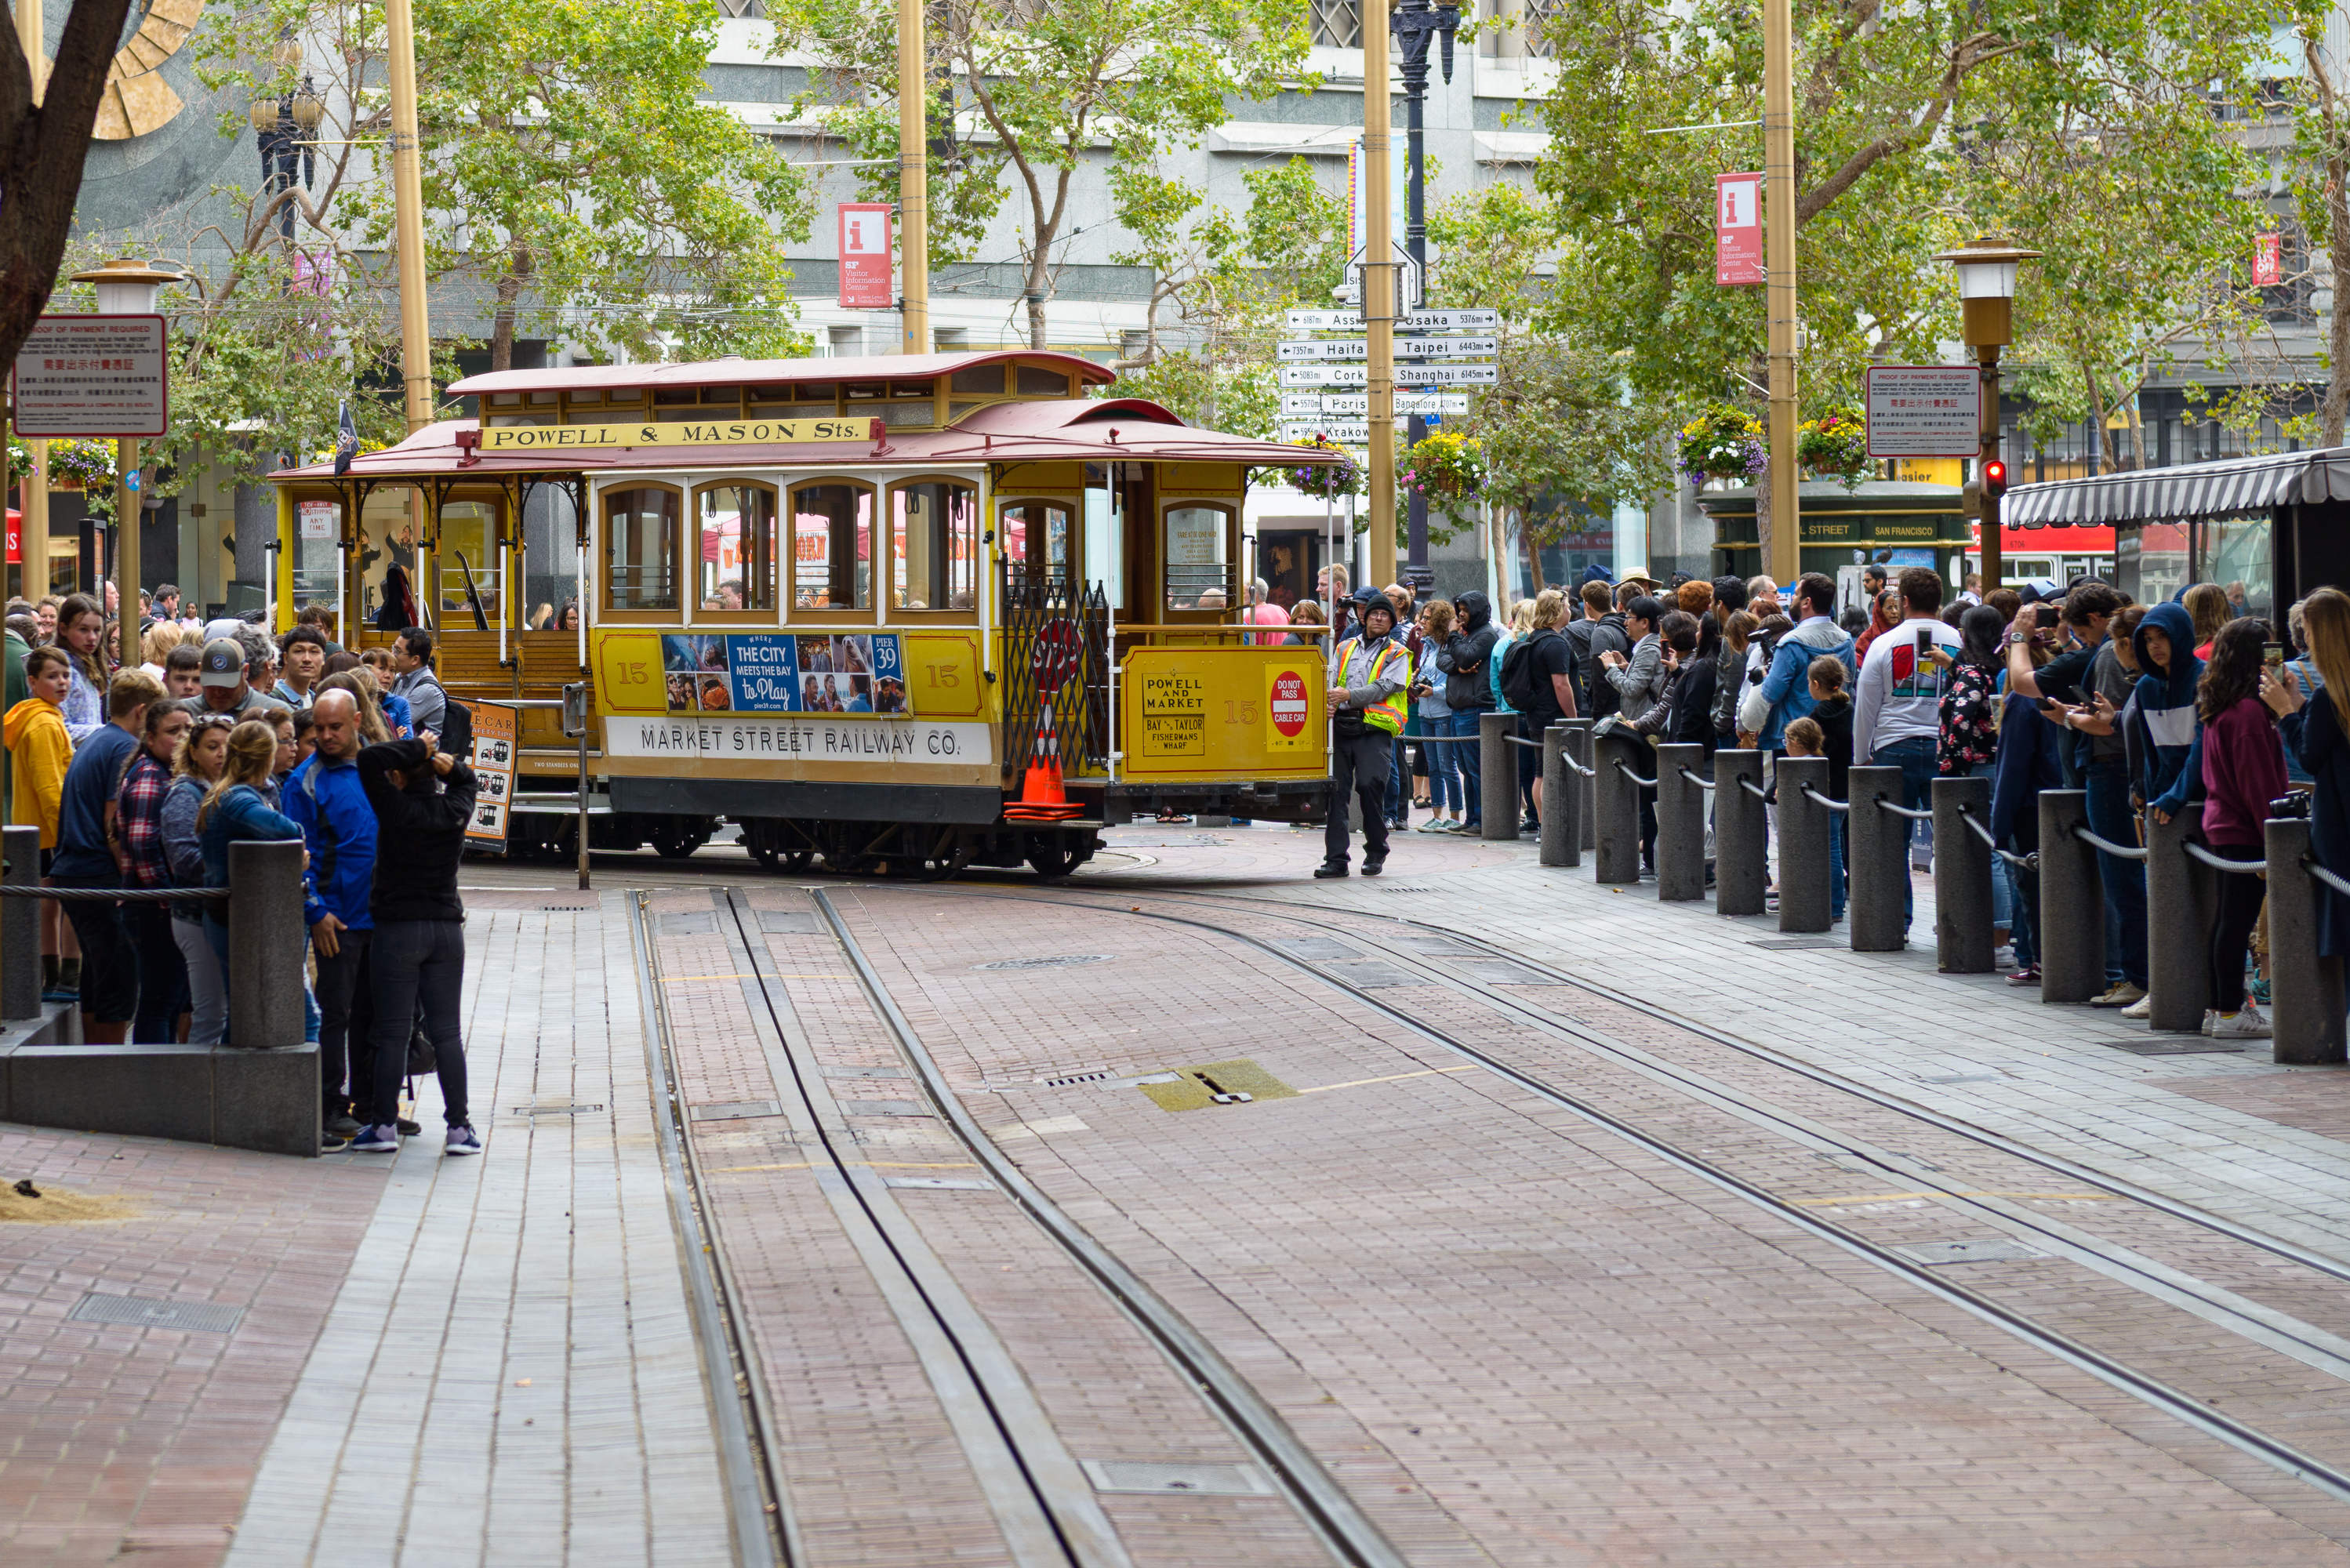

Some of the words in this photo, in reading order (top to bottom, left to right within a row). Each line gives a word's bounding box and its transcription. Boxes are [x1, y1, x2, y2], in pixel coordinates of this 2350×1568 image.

[1722, 235, 1734, 244] SF
[845, 261, 859, 269] SF
[1303, 315, 1322, 324] 6187mi
[1460, 315, 1483, 323] 5376mi
[1292, 346, 1315, 355] 7357mi
[1327, 344, 1364, 355] Haifa
[1405, 342, 1449, 354] Taipei
[1459, 342, 1483, 351] 6443mi
[1299, 370, 1320, 379] 5083mi
[1334, 370, 1364, 380] Cork
[1400, 370, 1455, 383] Shanghai
[1300, 400, 1321, 408] 5570mi
[1333, 398, 1366, 409] Paris
[1396, 398, 1436, 411] Bangalore
[494, 429, 617, 446] POWELL
[640, 426, 659, 442] &
[682, 423, 797, 441] MASON
[814, 422, 859, 438] Sts.
[1896, 471, 1932, 481] easier
[1809, 525, 1849, 535] STREET
[1875, 526, 1890, 535] SAN
[1892, 526, 1933, 536] FRANCISCO
[796, 535, 826, 561] ORN
[748, 635, 772, 644] WHERE
[875, 637, 894, 648] PIER
[736, 646, 758, 662] THE
[759, 646, 786, 662] CITY
[876, 648, 896, 670] 39
[617, 662, 649, 684] 15
[736, 666, 761, 676] MEETS
[761, 666, 776, 676] THE
[776, 666, 791, 676] BAY
[926, 665, 960, 688] 15
[1147, 679, 1202, 689] POWELL
[1278, 681, 1287, 690] DO
[1288, 680, 1301, 690] NOT
[742, 678, 757, 700] to
[757, 678, 790, 711] Play
[1282, 690, 1297, 699] PASS
[1147, 699, 1203, 708] MARKET
[1224, 700, 1258, 725] 15
[485, 715, 513, 730] CAR
[1275, 714, 1293, 723] CABLE
[1294, 714, 1305, 722] CAR
[1147, 720, 1161, 731] BAY
[1175, 719, 1202, 731] TAYLOR
[472, 727, 495, 736] AFETY
[497, 730, 513, 739] TIPS
[641, 724, 723, 750] MARKET
[733, 726, 814, 752] STREET
[825, 728, 915, 755] RAILWAY
[927, 730, 961, 756] CO.
